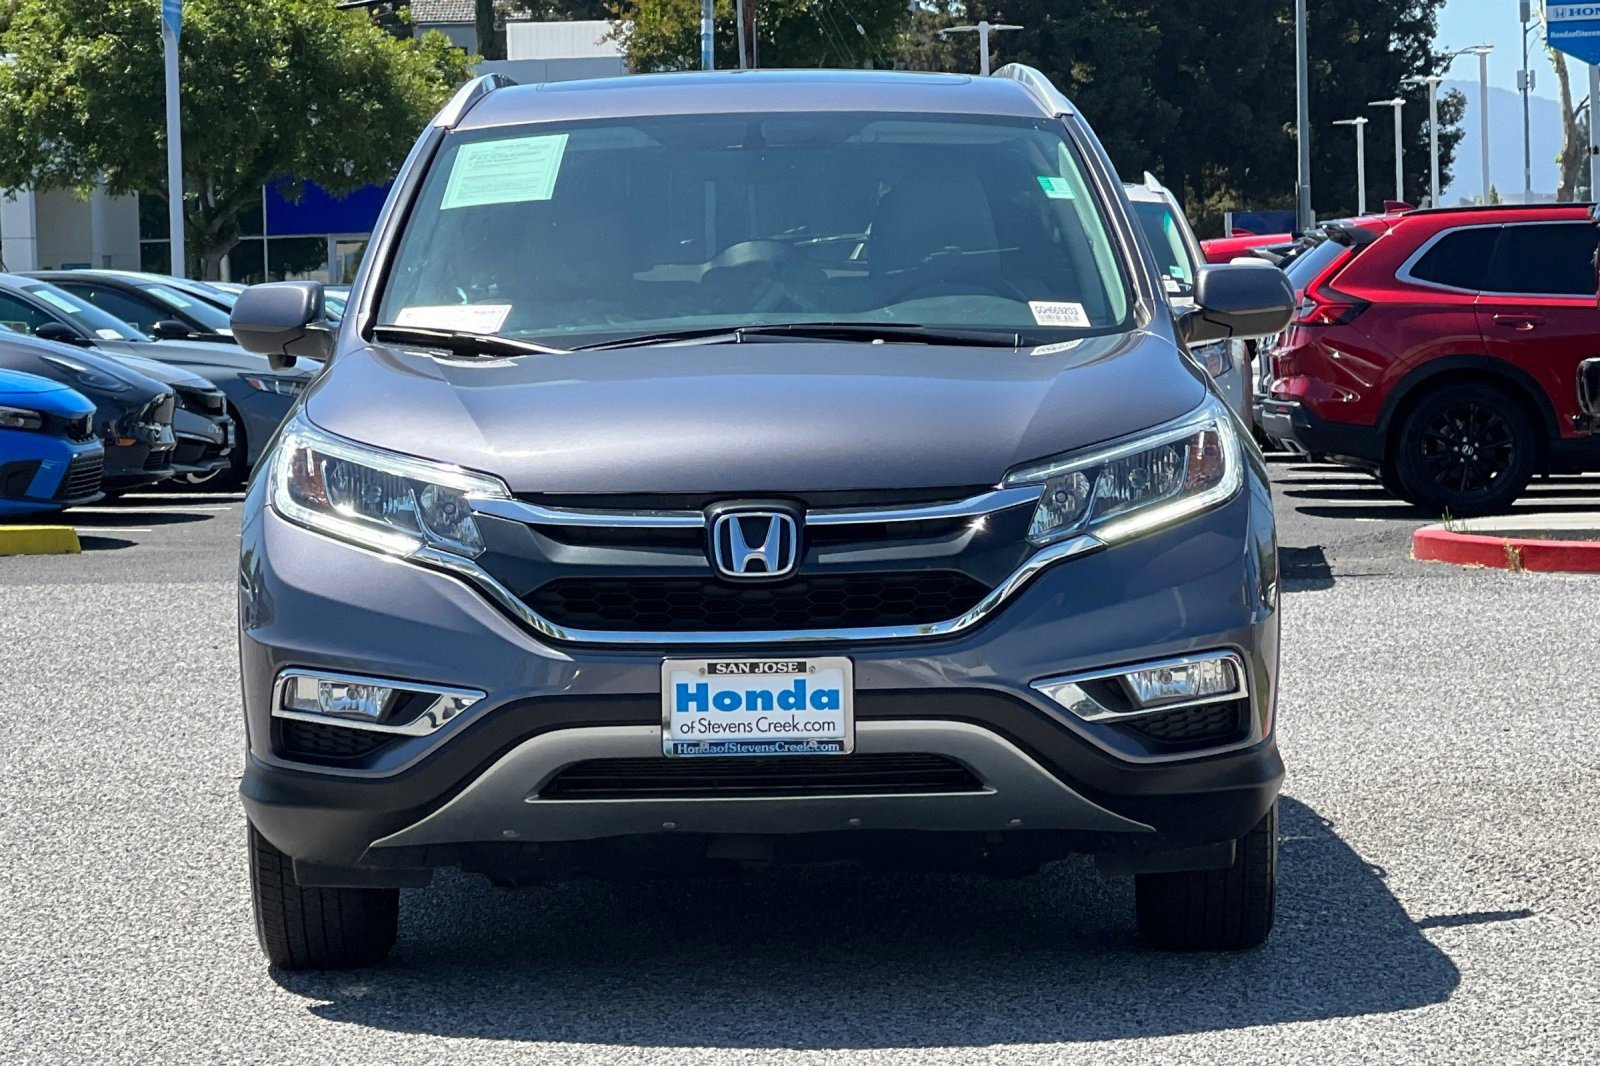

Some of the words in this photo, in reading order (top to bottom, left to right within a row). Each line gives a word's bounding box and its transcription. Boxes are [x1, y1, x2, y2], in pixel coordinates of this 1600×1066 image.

[715, 662, 750, 674] SAN
[754, 662, 799, 674] JOSE
[675, 679, 840, 713] Honda
[680, 721, 696, 734] of
[698, 717, 753, 734] Stevens
[755, 714, 836, 733] Creek.com
[677, 740, 840, 754] HondaofStevensCreek.com
